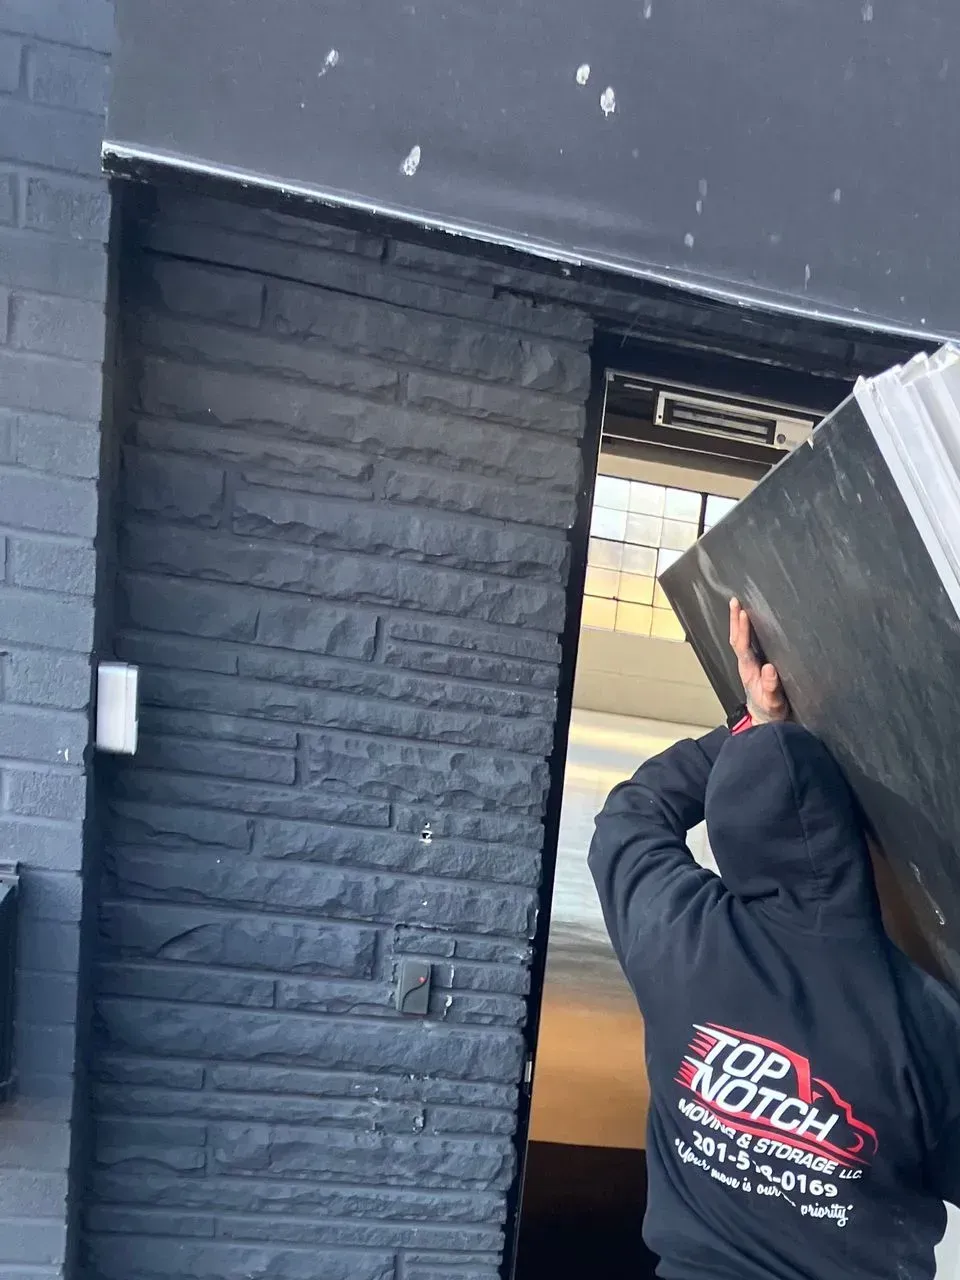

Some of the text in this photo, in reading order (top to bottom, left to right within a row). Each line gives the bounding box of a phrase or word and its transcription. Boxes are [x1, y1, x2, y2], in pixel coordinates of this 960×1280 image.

[692, 1023, 791, 1083] TOP
[684, 1055, 839, 1142] NOTCH
[678, 1098, 736, 1139] MOVING
[736, 1133, 753, 1149] &
[753, 1138, 839, 1175] STORAGE
[693, 1130, 838, 1197] 201-5-0169
[711, 1167, 740, 1189] move
[742, 1177, 751, 1192] is
[756, 1183, 782, 1197] our
